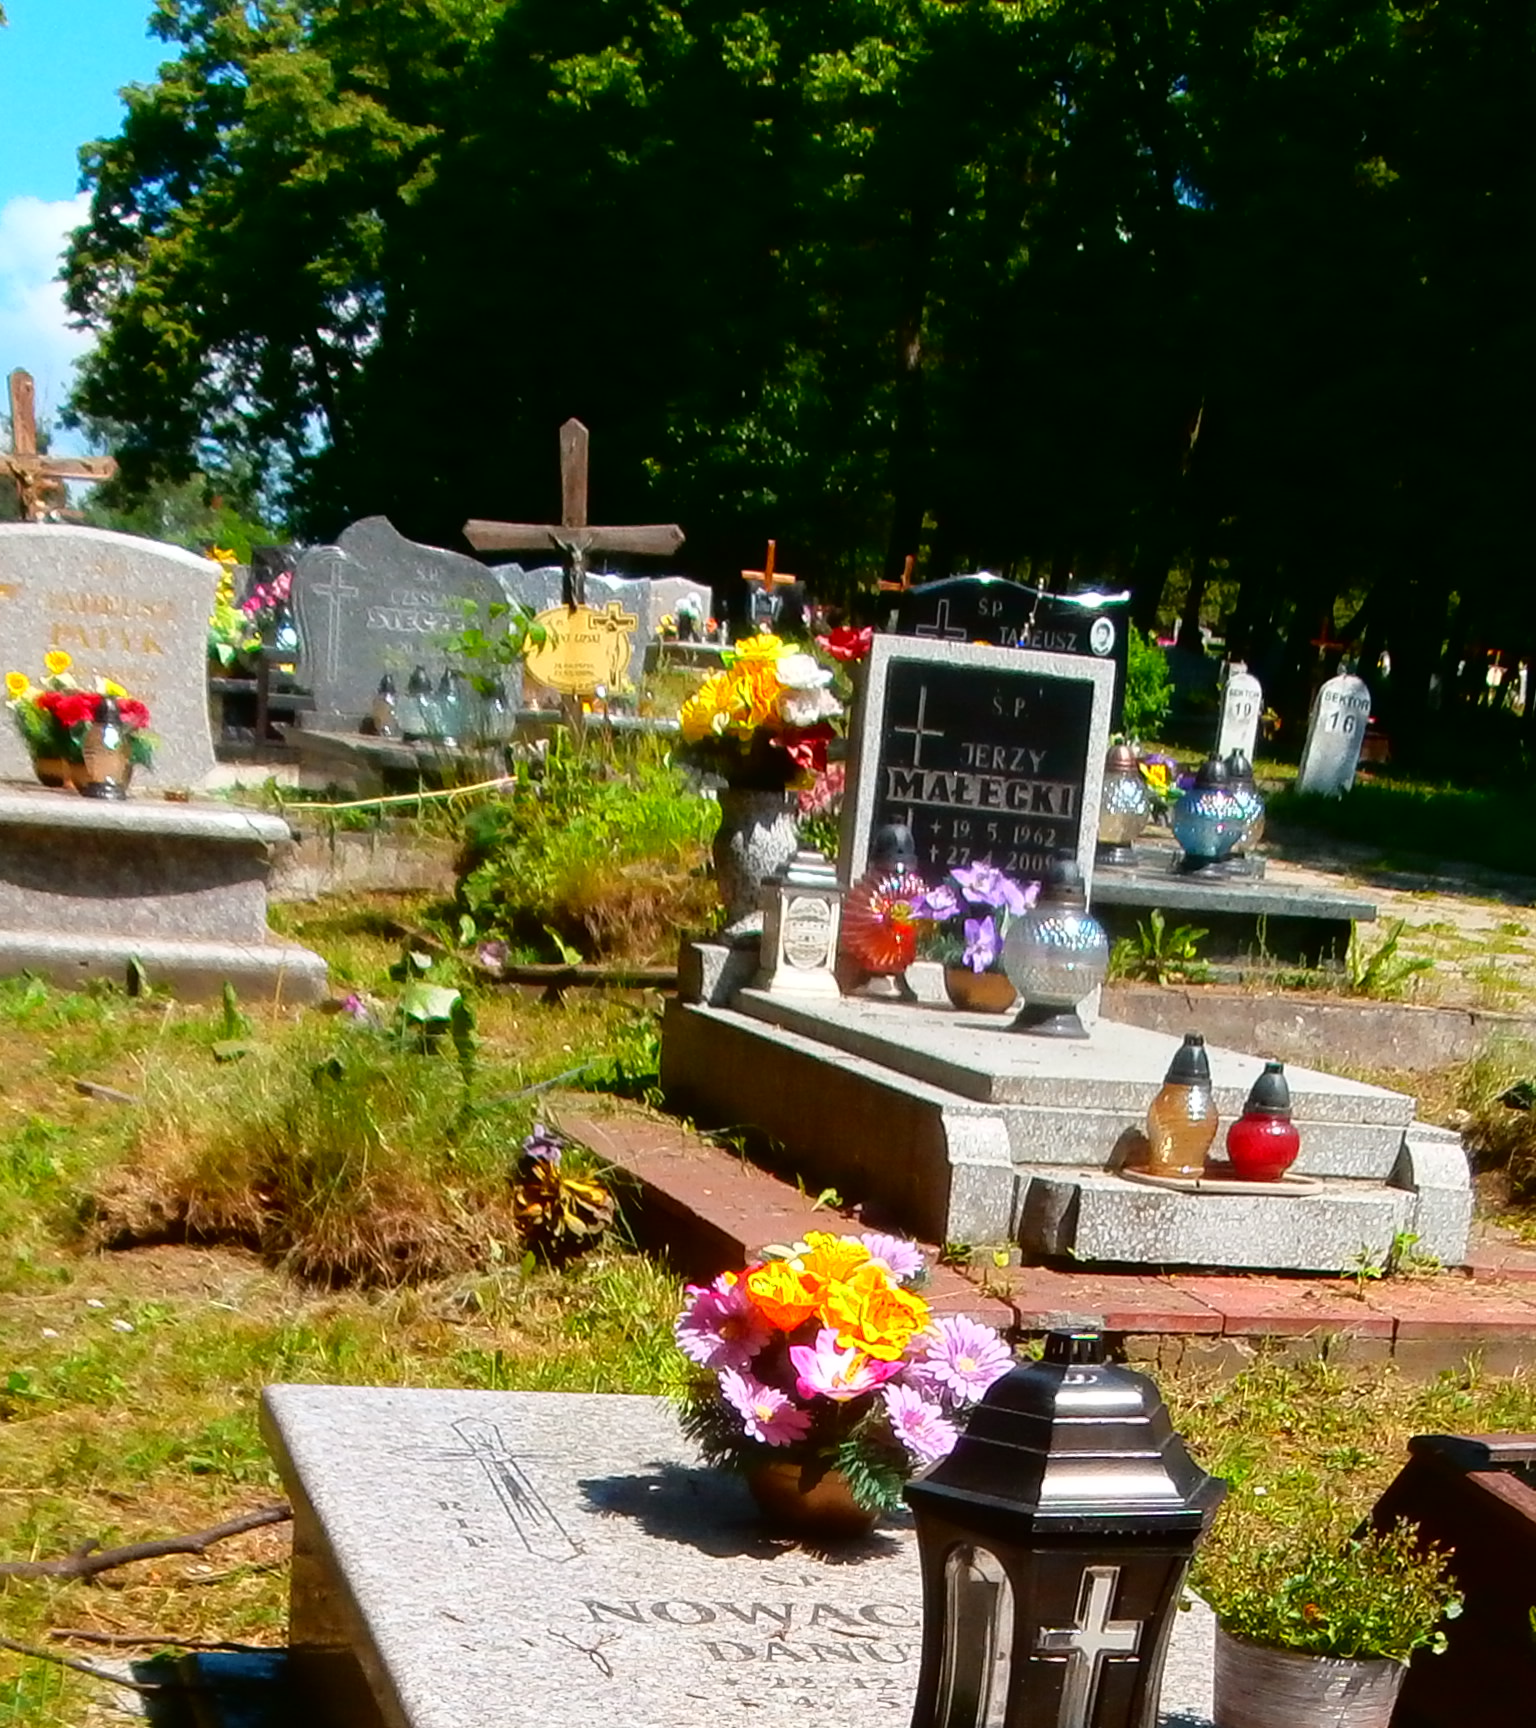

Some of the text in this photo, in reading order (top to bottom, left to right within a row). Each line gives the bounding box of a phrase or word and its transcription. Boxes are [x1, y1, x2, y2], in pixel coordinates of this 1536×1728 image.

[1324, 690, 1370, 712] SEKTOR
[1330, 711, 1355, 734] 16
[960, 742, 1048, 773] JERZY
[886, 765, 1079, 818] MAŁECKI
[579, 1600, 923, 1628] NOWAC
[702, 1640, 923, 1664] DANU
